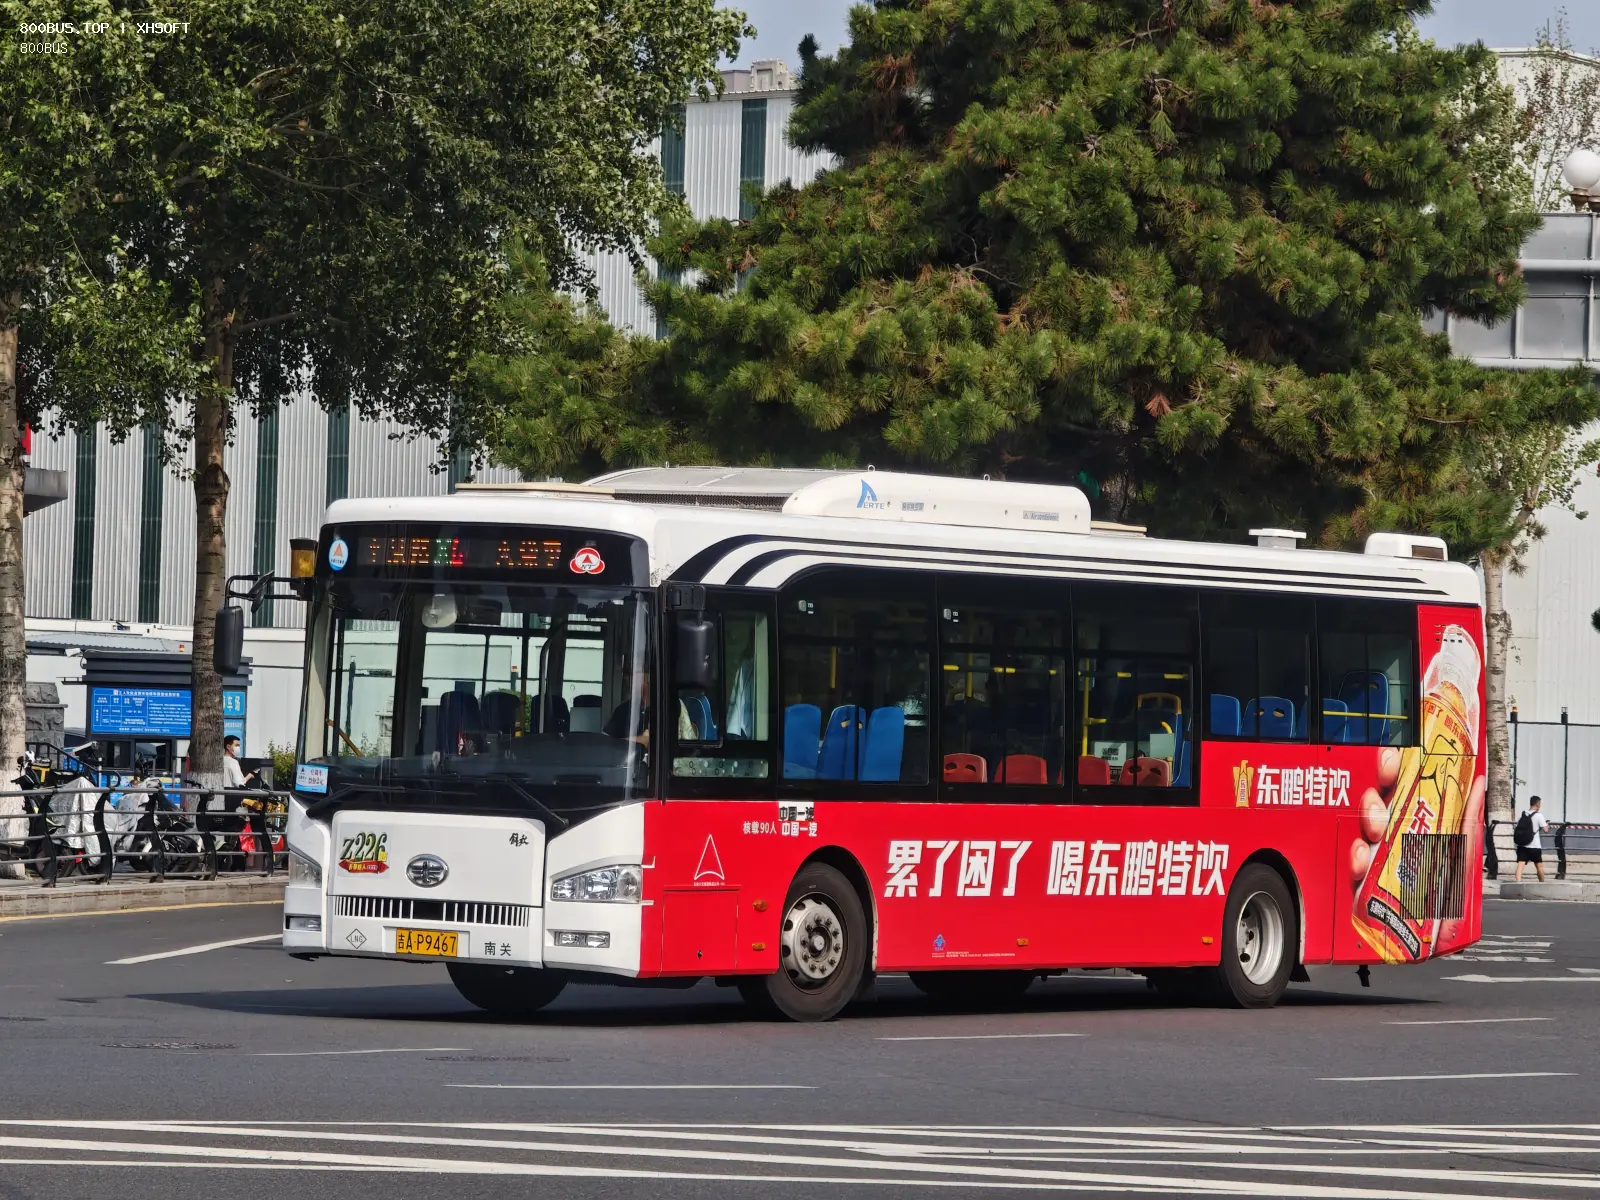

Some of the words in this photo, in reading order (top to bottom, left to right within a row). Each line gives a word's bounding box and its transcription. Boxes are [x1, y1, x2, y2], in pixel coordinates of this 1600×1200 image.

[1256, 764, 1351, 807] 东鹏特饮
[779, 806, 814, 821] 中国一汽
[743, 821, 777, 835] 核载90人
[781, 821, 818, 837] 中国一汽
[340, 831, 388, 862] Z226
[883, 839, 1033, 897] 累了困了
[1046, 839, 1230, 896] 喝东鹏特饮
[350, 934, 363, 943] LNG
[484, 941, 512, 957] 南关
